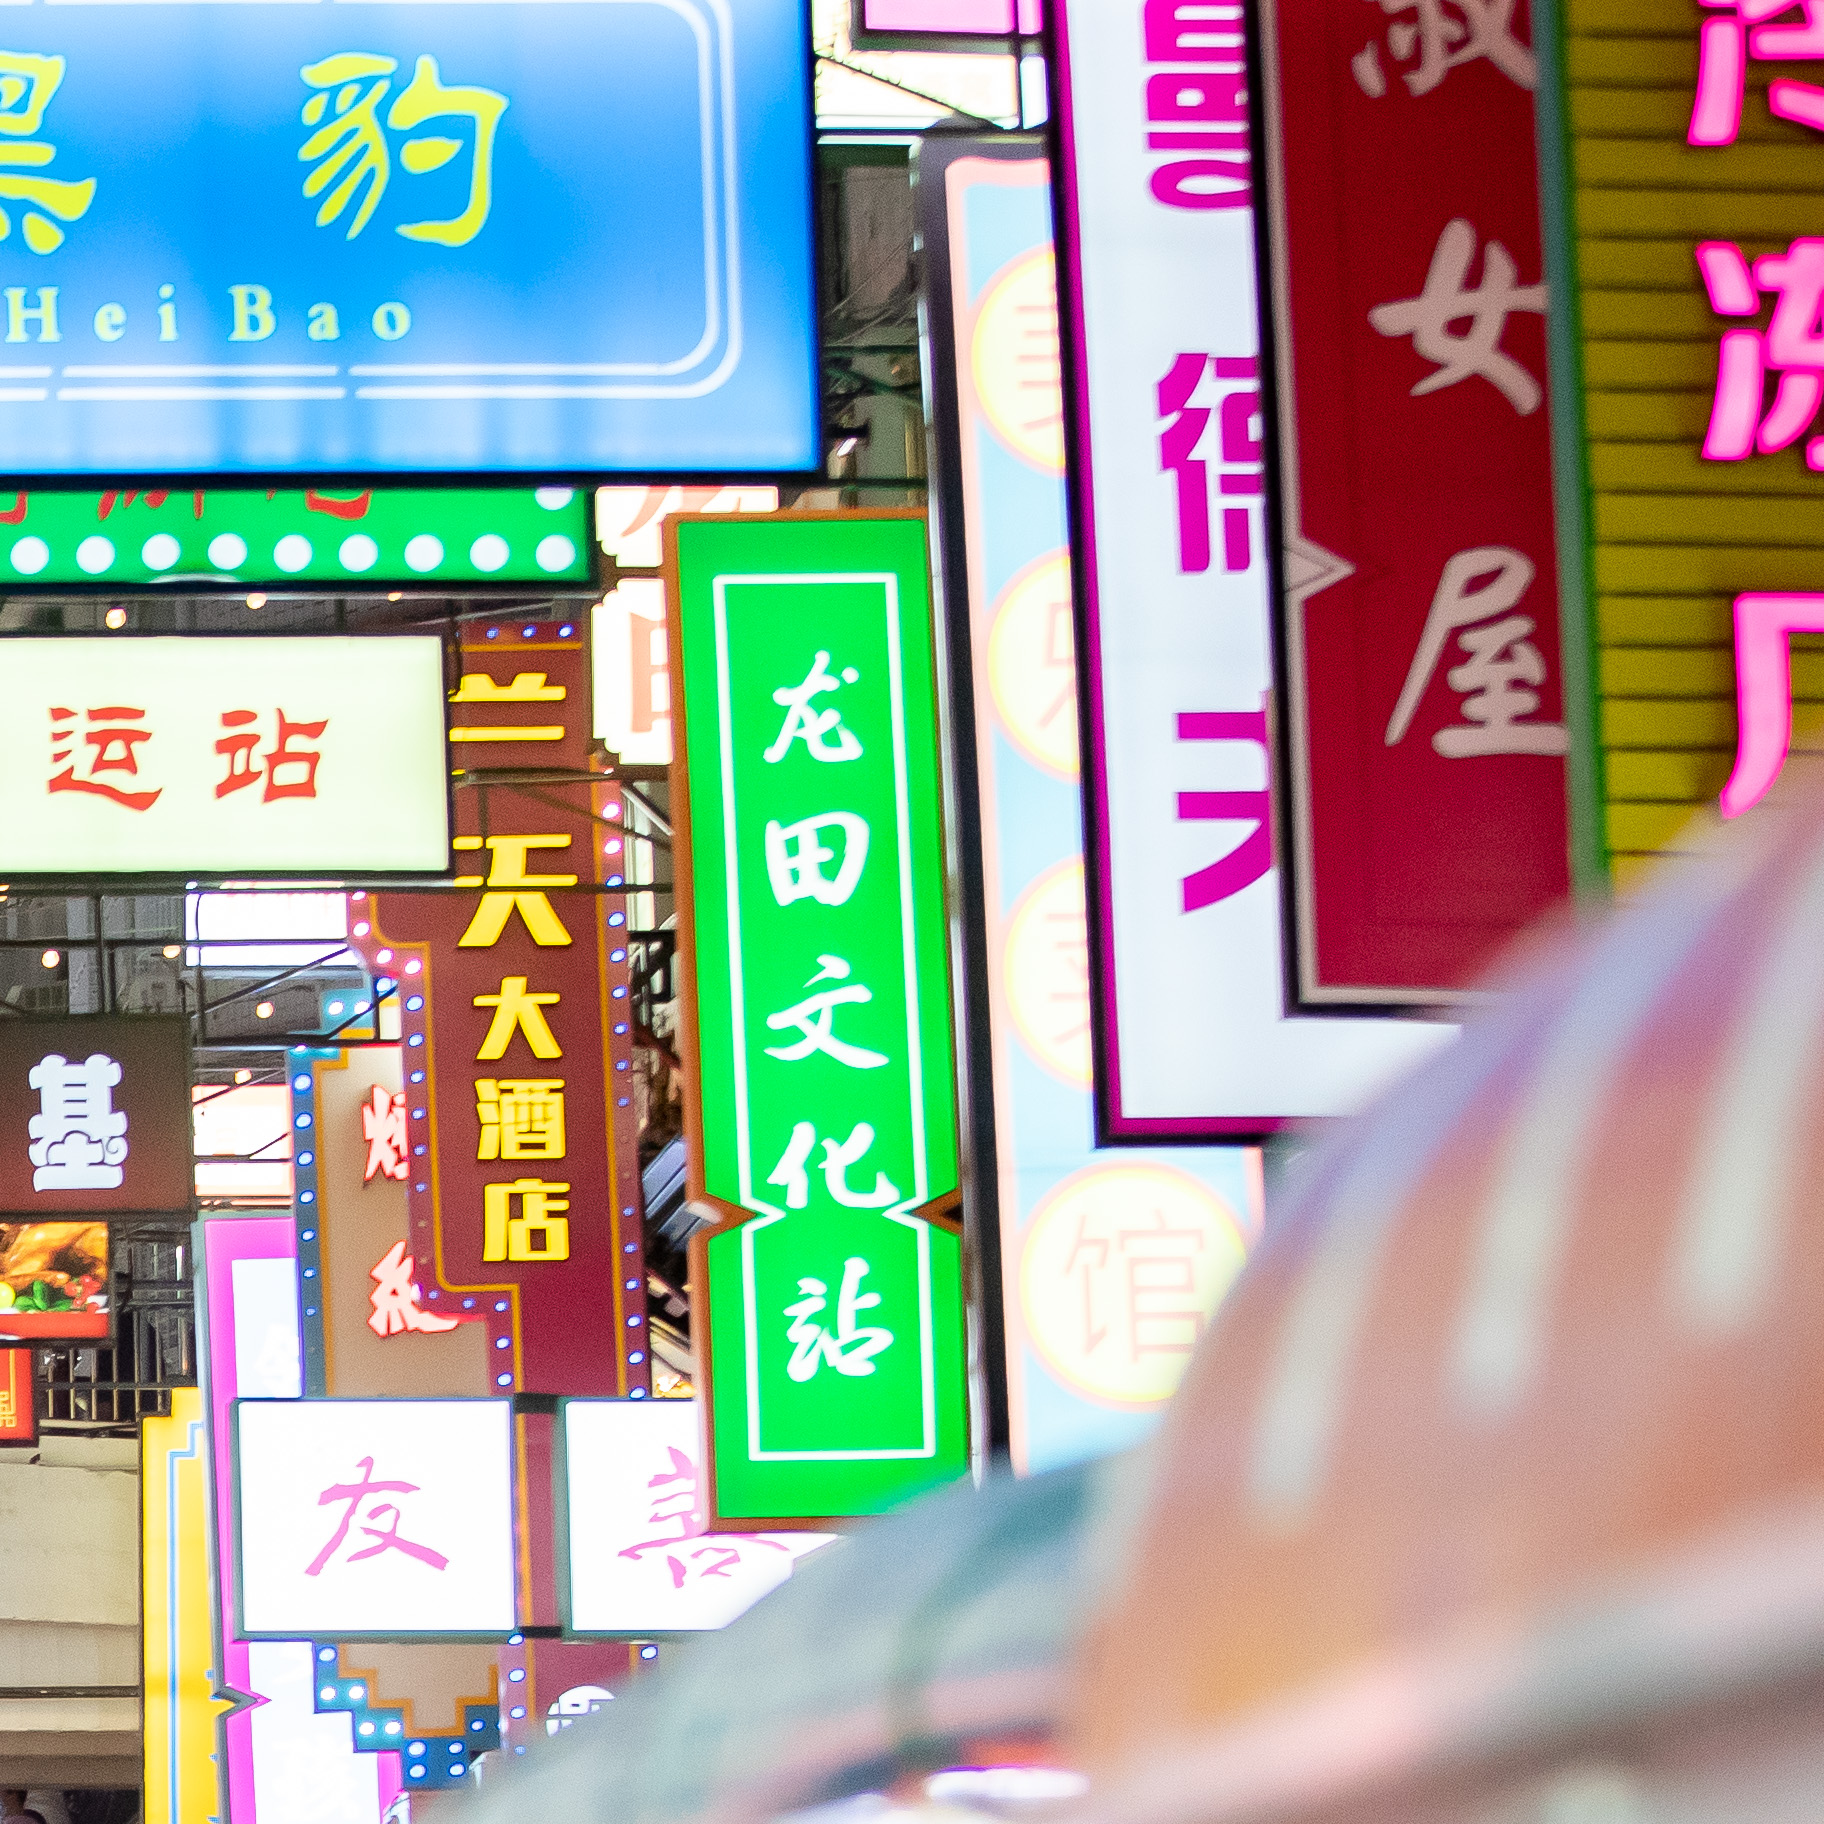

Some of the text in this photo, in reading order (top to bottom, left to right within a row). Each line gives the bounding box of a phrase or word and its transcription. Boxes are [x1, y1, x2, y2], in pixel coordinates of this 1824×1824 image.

[5, 283, 411, 343] Hei Bao
[762, 650, 901, 1382] 龙田文化站
